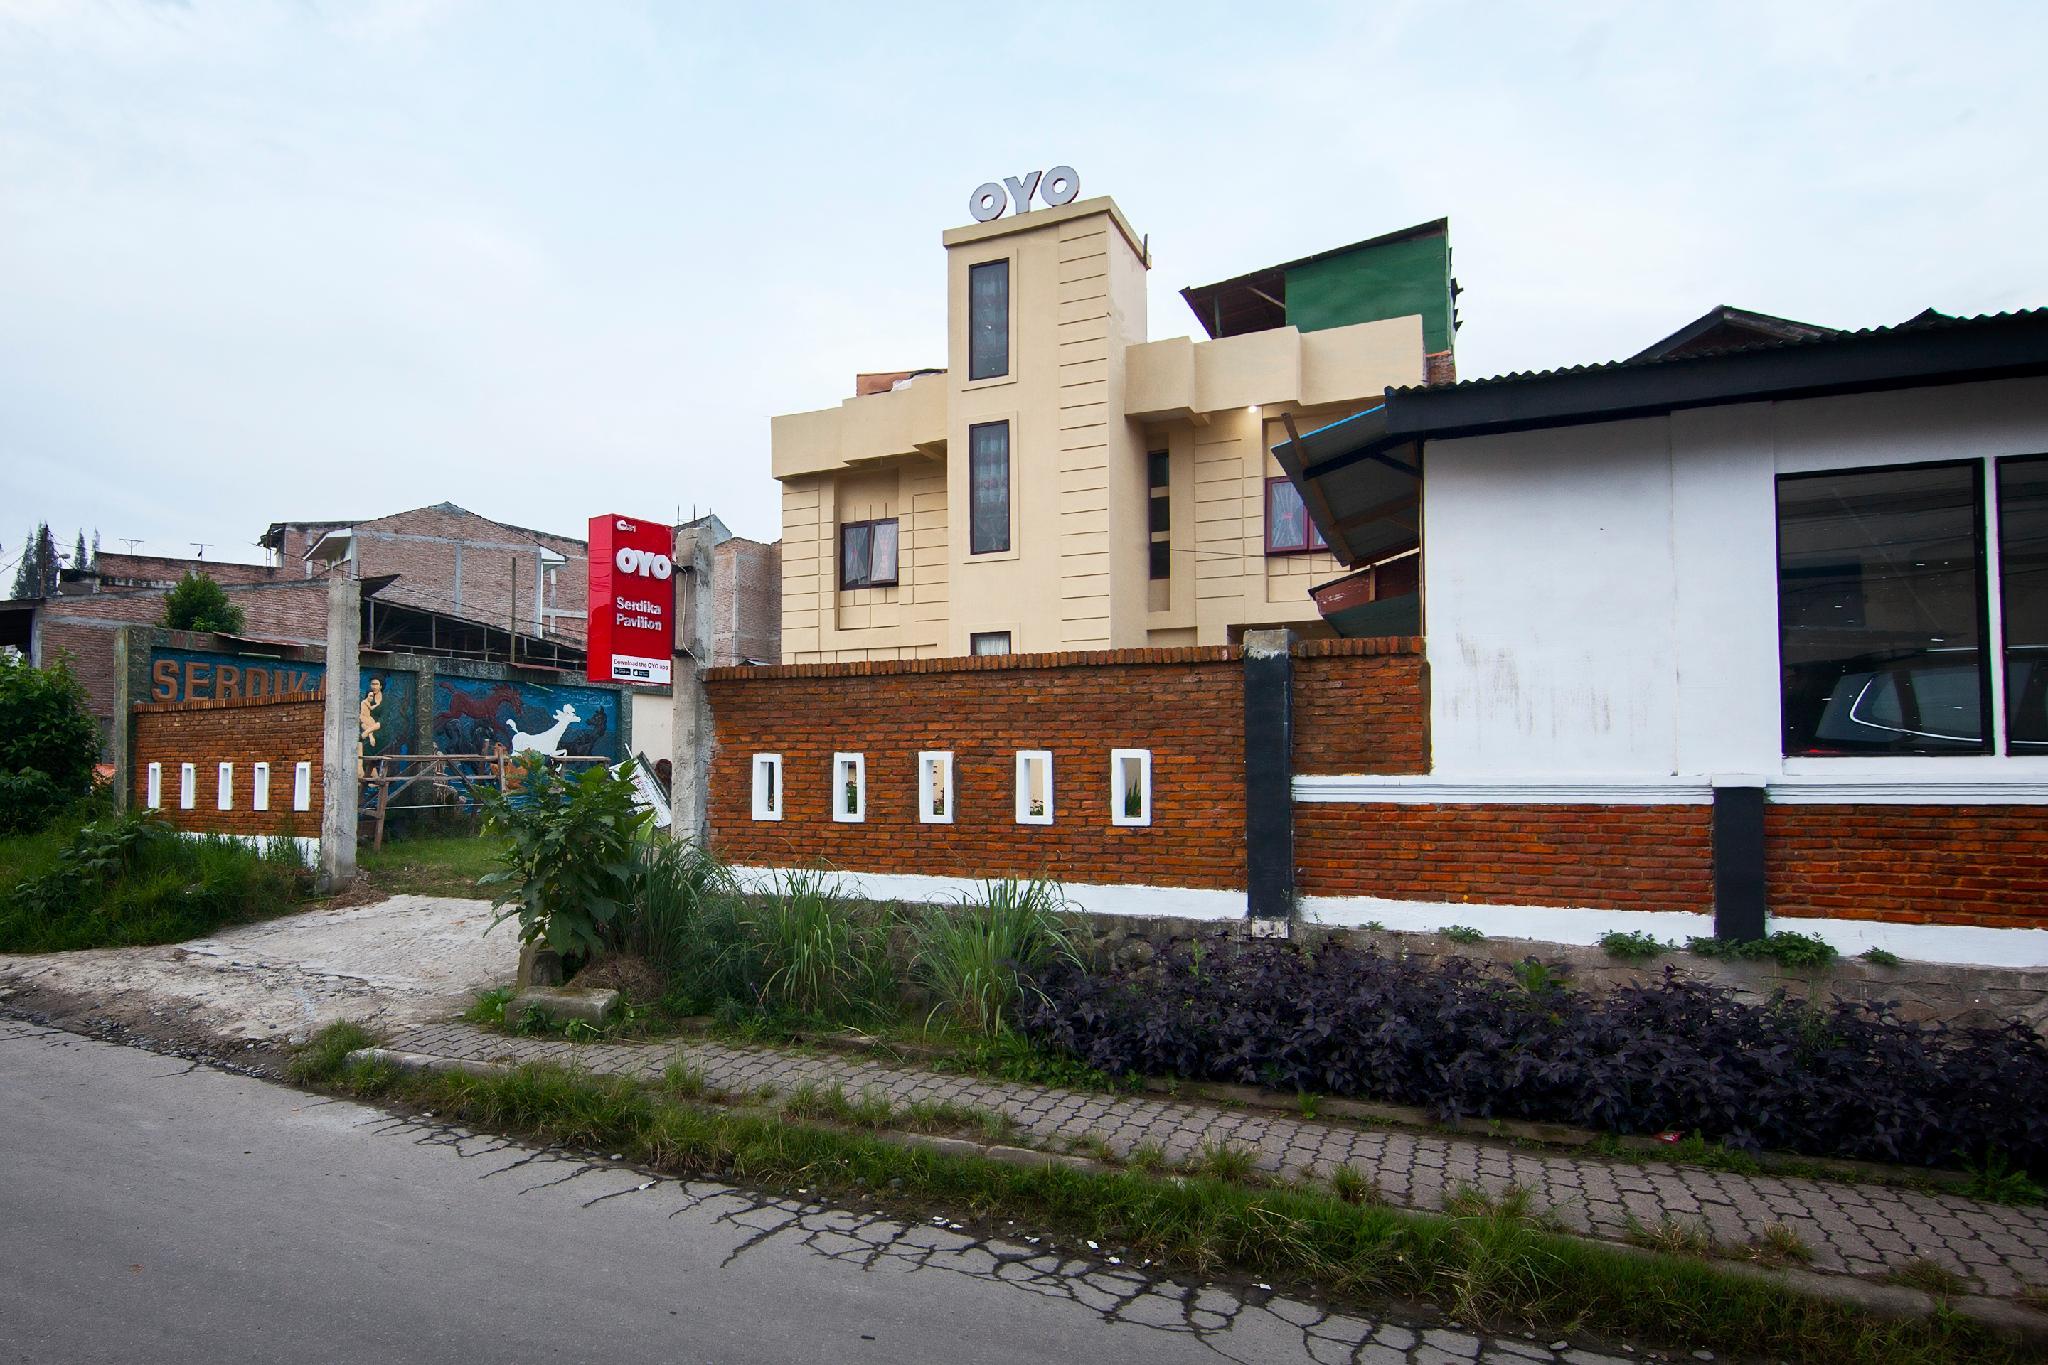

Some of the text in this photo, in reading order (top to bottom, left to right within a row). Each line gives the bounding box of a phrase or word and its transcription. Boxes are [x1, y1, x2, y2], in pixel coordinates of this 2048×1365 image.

[969, 166, 1080, 223] OYO
[616, 547, 672, 579] OYO
[616, 596, 662, 615] Serdika
[616, 613, 663, 631] Pavilion
[152, 660, 326, 703] SERDIK
